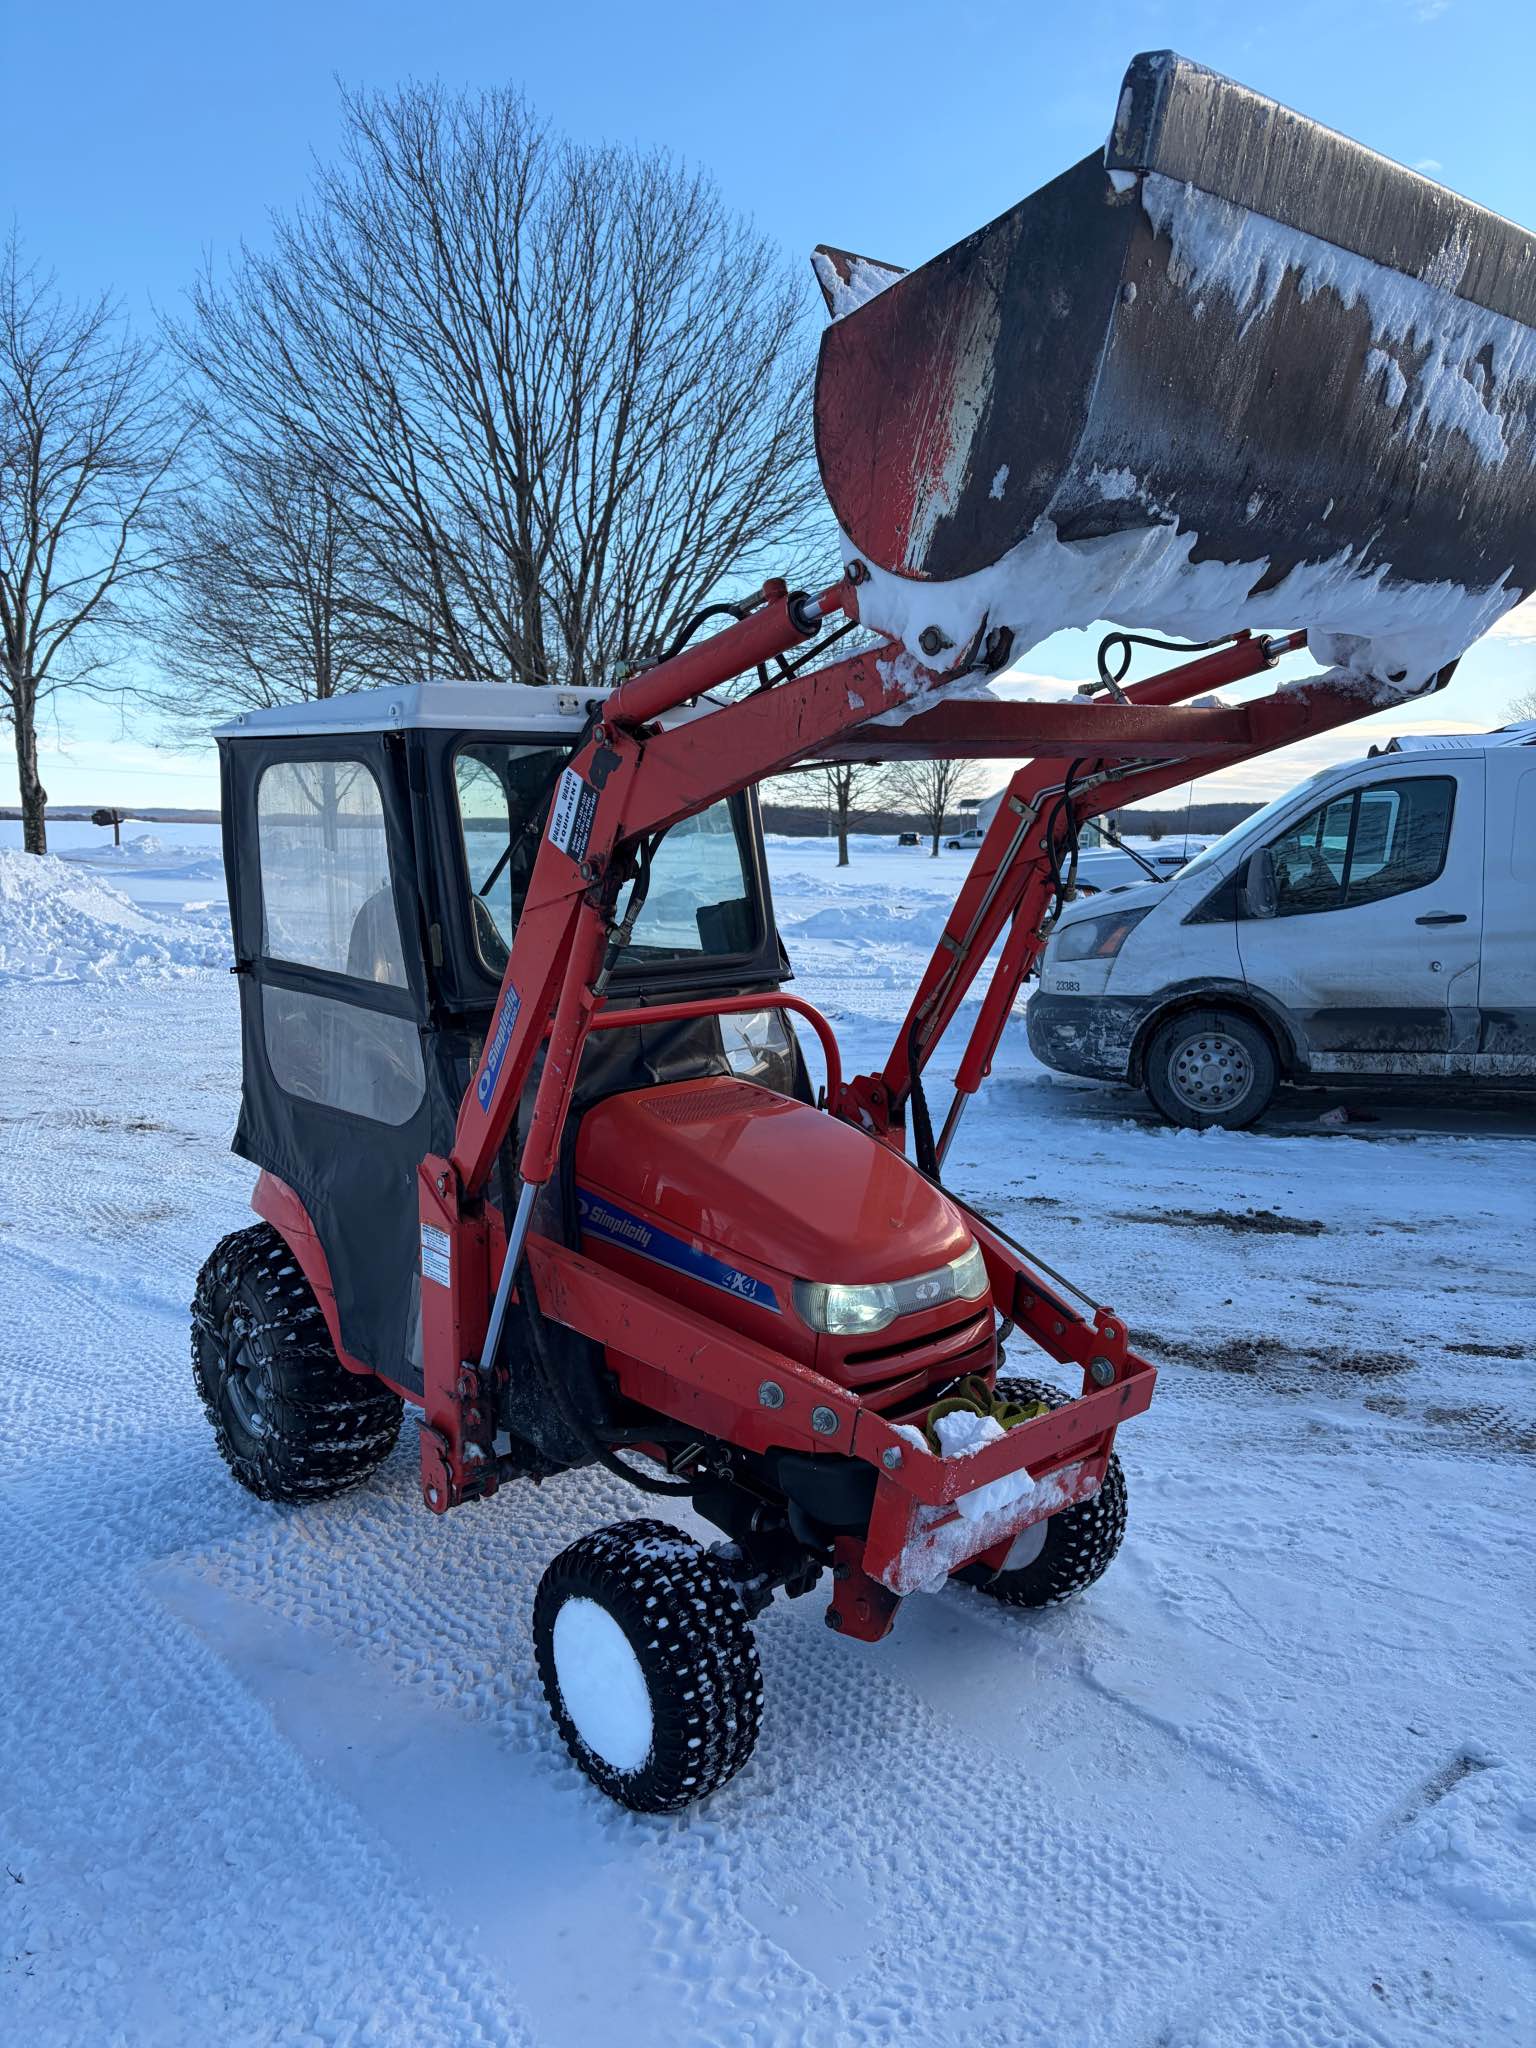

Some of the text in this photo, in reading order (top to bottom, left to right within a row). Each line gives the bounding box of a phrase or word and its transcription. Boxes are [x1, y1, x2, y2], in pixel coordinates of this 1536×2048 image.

[552, 771, 573, 842] WALKER WALKER
[560, 781, 577, 843] EQUIPMENT
[1056, 980, 1081, 992] 23383
[487, 985, 518, 1073] Simplicity
[589, 1206, 653, 1248] Simplicity
